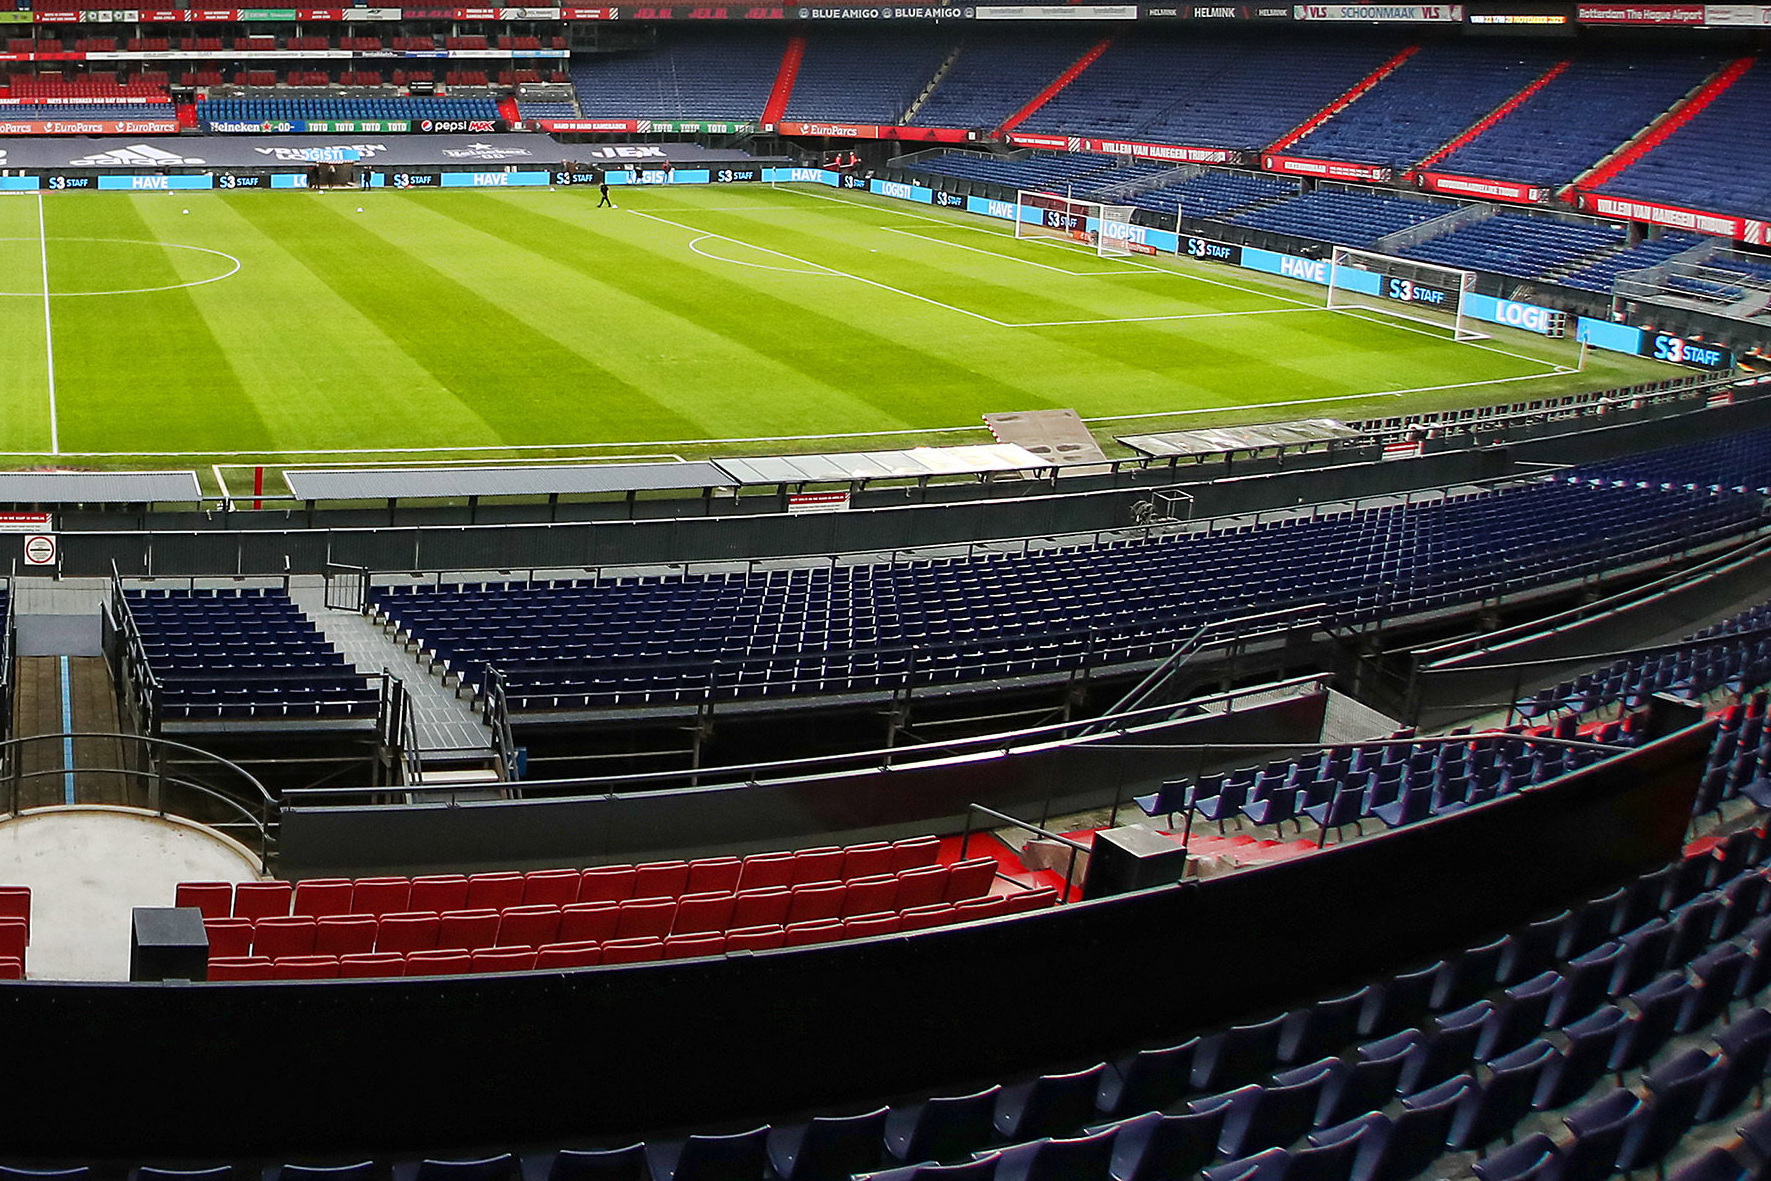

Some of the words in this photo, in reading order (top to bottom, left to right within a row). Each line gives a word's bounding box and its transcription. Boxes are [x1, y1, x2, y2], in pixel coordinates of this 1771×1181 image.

[812, 9, 839, 18] BLUE
[842, 9, 878, 18] AMIGO
[895, 8, 922, 18] BLUE
[924, 8, 961, 17] AMIGO
[1194, 7, 1235, 18] HELMINK
[1310, 7, 1327, 18] VLS
[1341, 7, 1414, 18] SCHOONMAAK
[1422, 7, 1440, 18] VLS
[1579, 9, 1624, 19] Rotterdam
[1627, 9, 1642, 19] The
[1644, 10, 1669, 22] Hague
[1671, 9, 1703, 23] Airport
[54, 122, 102, 133] EuroParcs
[126, 122, 175, 133] EuroParcs
[210, 122, 260, 132] Heineken
[309, 122, 328, 132] TOTO
[335, 122, 354, 132] TOTO
[362, 122, 381, 132] TOTO
[388, 122, 407, 132] TOTO
[435, 121, 467, 132] pepsi
[468, 120, 495, 132] MAX
[653, 122, 672, 133] TOTO
[708, 123, 727, 133] TOTO
[811, 125, 857, 136] EuroParcs
[591, 147, 667, 158] JEX
[1102, 141, 1132, 154] WILLEM
[1133, 143, 1148, 156] VAN
[1150, 145, 1187, 160] HANEGEM
[69, 154, 206, 166] adidas
[393, 173, 409, 187] S3
[410, 175, 431, 185] STAFF
[473, 174, 508, 186] HAVE
[572, 173, 593, 184] STAFF
[718, 169, 732, 181] S3
[733, 170, 753, 180] STAFF
[791, 169, 822, 182] HAVE
[48, 177, 65, 190] S3
[66, 178, 88, 188] STAFF
[133, 176, 168, 189] HAVE
[219, 176, 235, 189] S3
[236, 177, 258, 188] STAFF
[882, 182, 911, 198] LOGISTI
[937, 190, 948, 206] S3
[988, 202, 1013, 219] HAVE
[1598, 198, 1632, 216] WILLEM
[1633, 204, 1650, 220] VAN
[1047, 211, 1060, 228] S3
[1104, 222, 1146, 244] LOGISTI
[1187, 239, 1206, 256] S3
[1206, 244, 1231, 259] STAFF
[1281, 256, 1325, 282] HAVE
[1389, 277, 1412, 301] S3
[1413, 287, 1444, 305] STAFF
[1653, 335, 1685, 363] S3
[1685, 344, 1721, 366] STAFF
